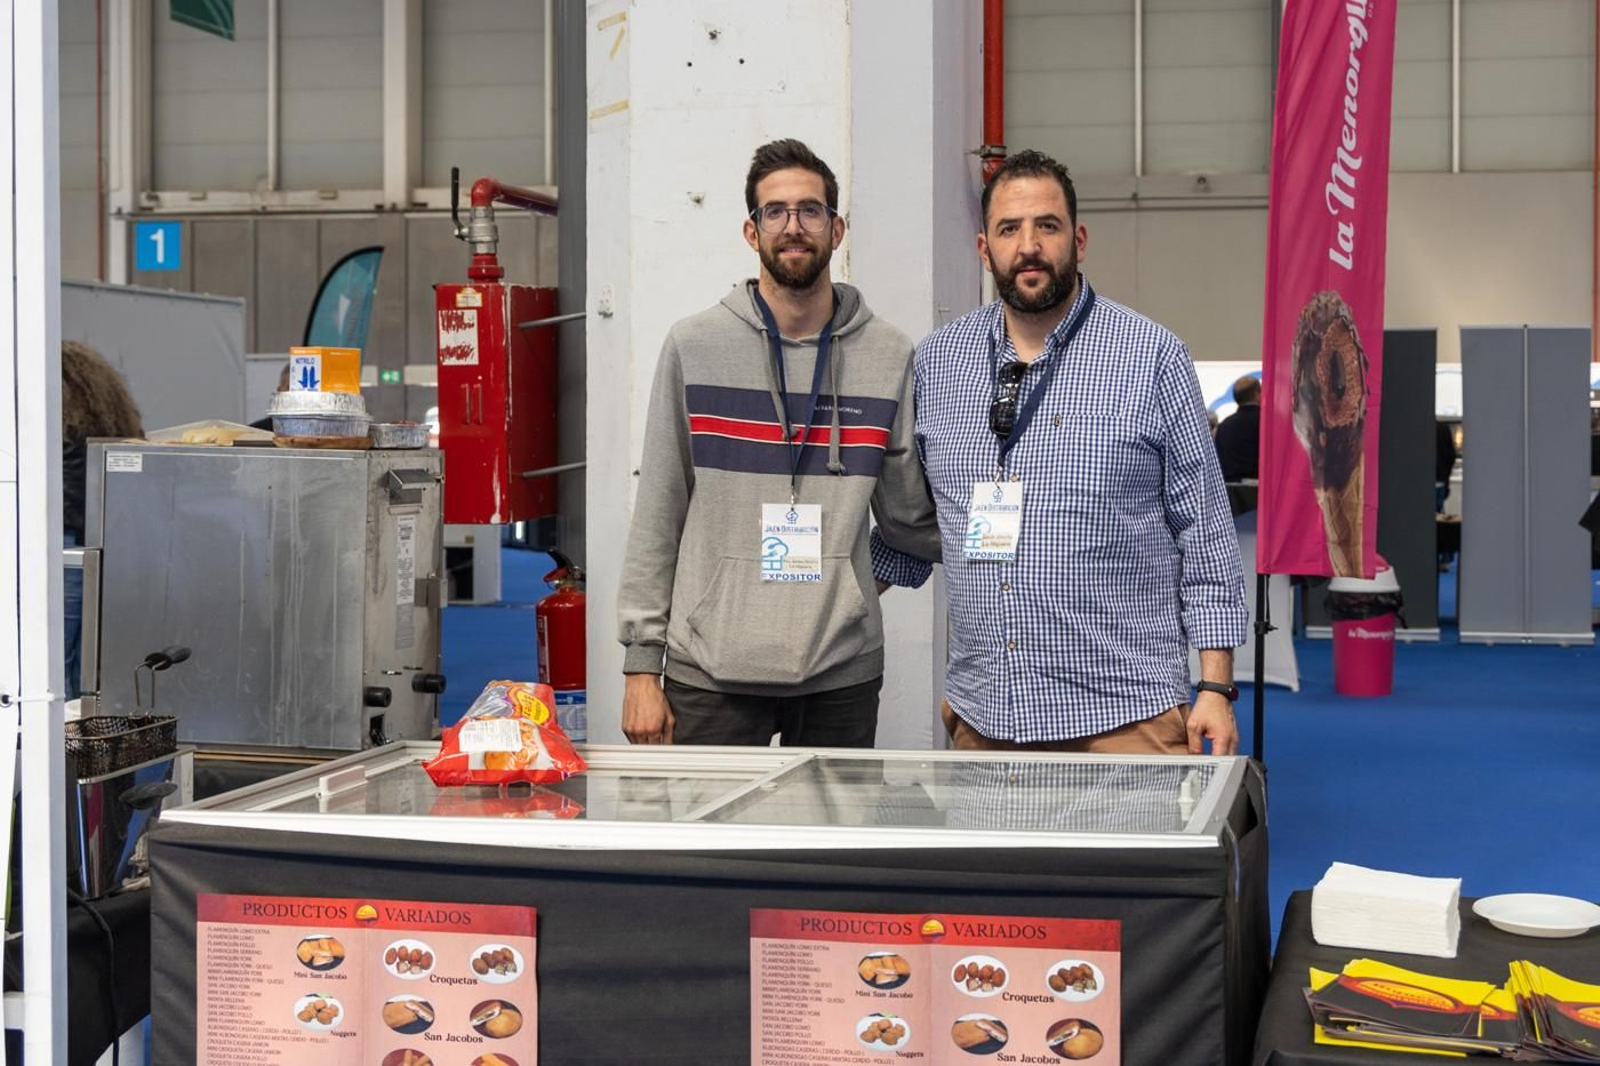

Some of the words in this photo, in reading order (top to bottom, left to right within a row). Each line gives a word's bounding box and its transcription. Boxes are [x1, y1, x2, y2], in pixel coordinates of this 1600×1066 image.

[150, 228, 164, 264] 1
[242, 903, 346, 919] PRODUCTOS
[385, 907, 472, 925] VARIADOS
[800, 917, 913, 936] PRODUCTOS
[952, 922, 1047, 940] VARIADOS
[429, 974, 478, 986] Croquetas
[1002, 992, 1054, 1005] Croquetas
[330, 1030, 356, 1038] Nuggets
[424, 1032, 443, 1042] San
[446, 1032, 483, 1043] Jacobos
[997, 1052, 1016, 1062] San
[1020, 1054, 1061, 1065] Jacobos
